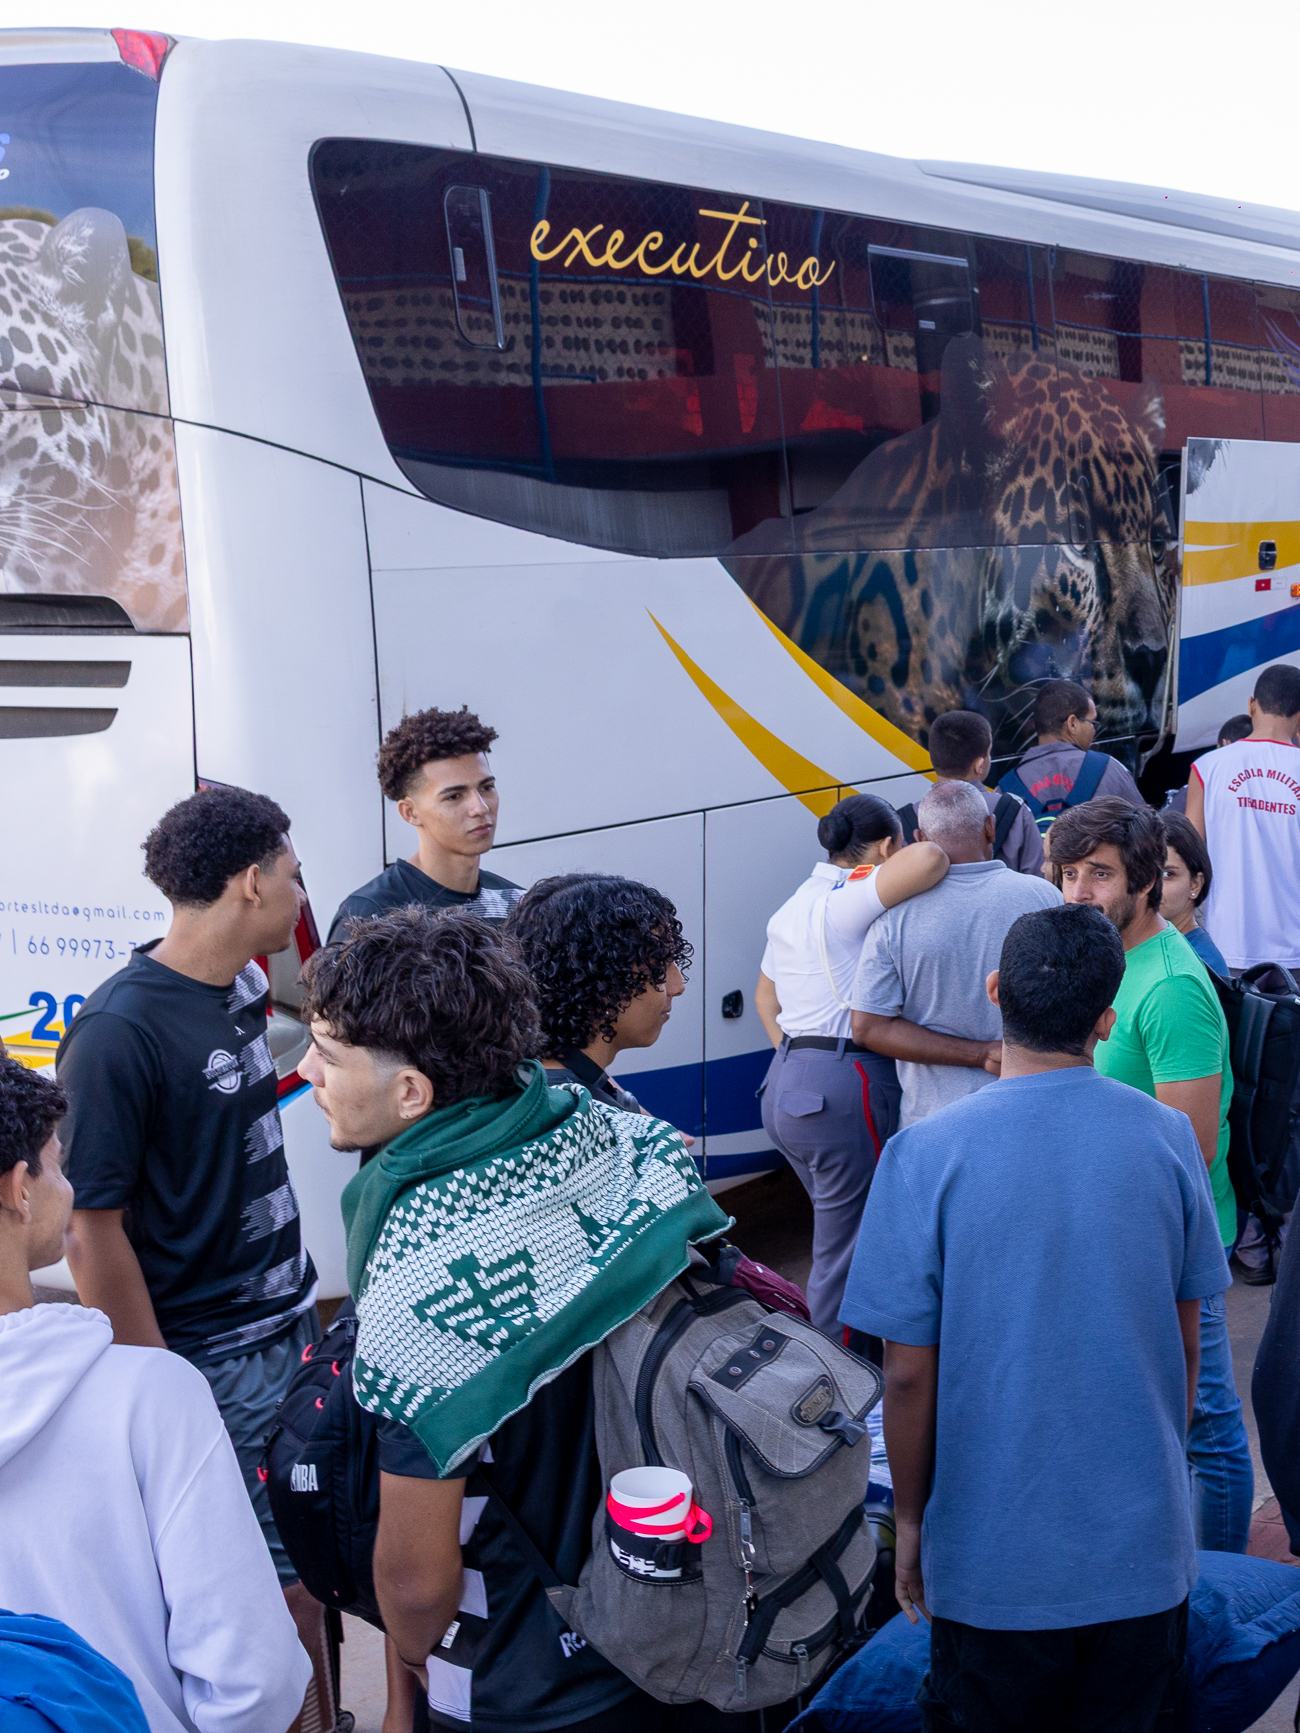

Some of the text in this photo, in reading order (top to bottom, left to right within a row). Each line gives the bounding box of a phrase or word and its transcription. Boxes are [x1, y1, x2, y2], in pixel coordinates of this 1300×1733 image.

[530, 201, 836, 290] executivo
[1227, 768, 1263, 793] ESCOLA
[1236, 796, 1297, 816] TIRADENTES
[56, 937, 147, 960] 99973-
[296, 1463, 319, 1492] NBA
